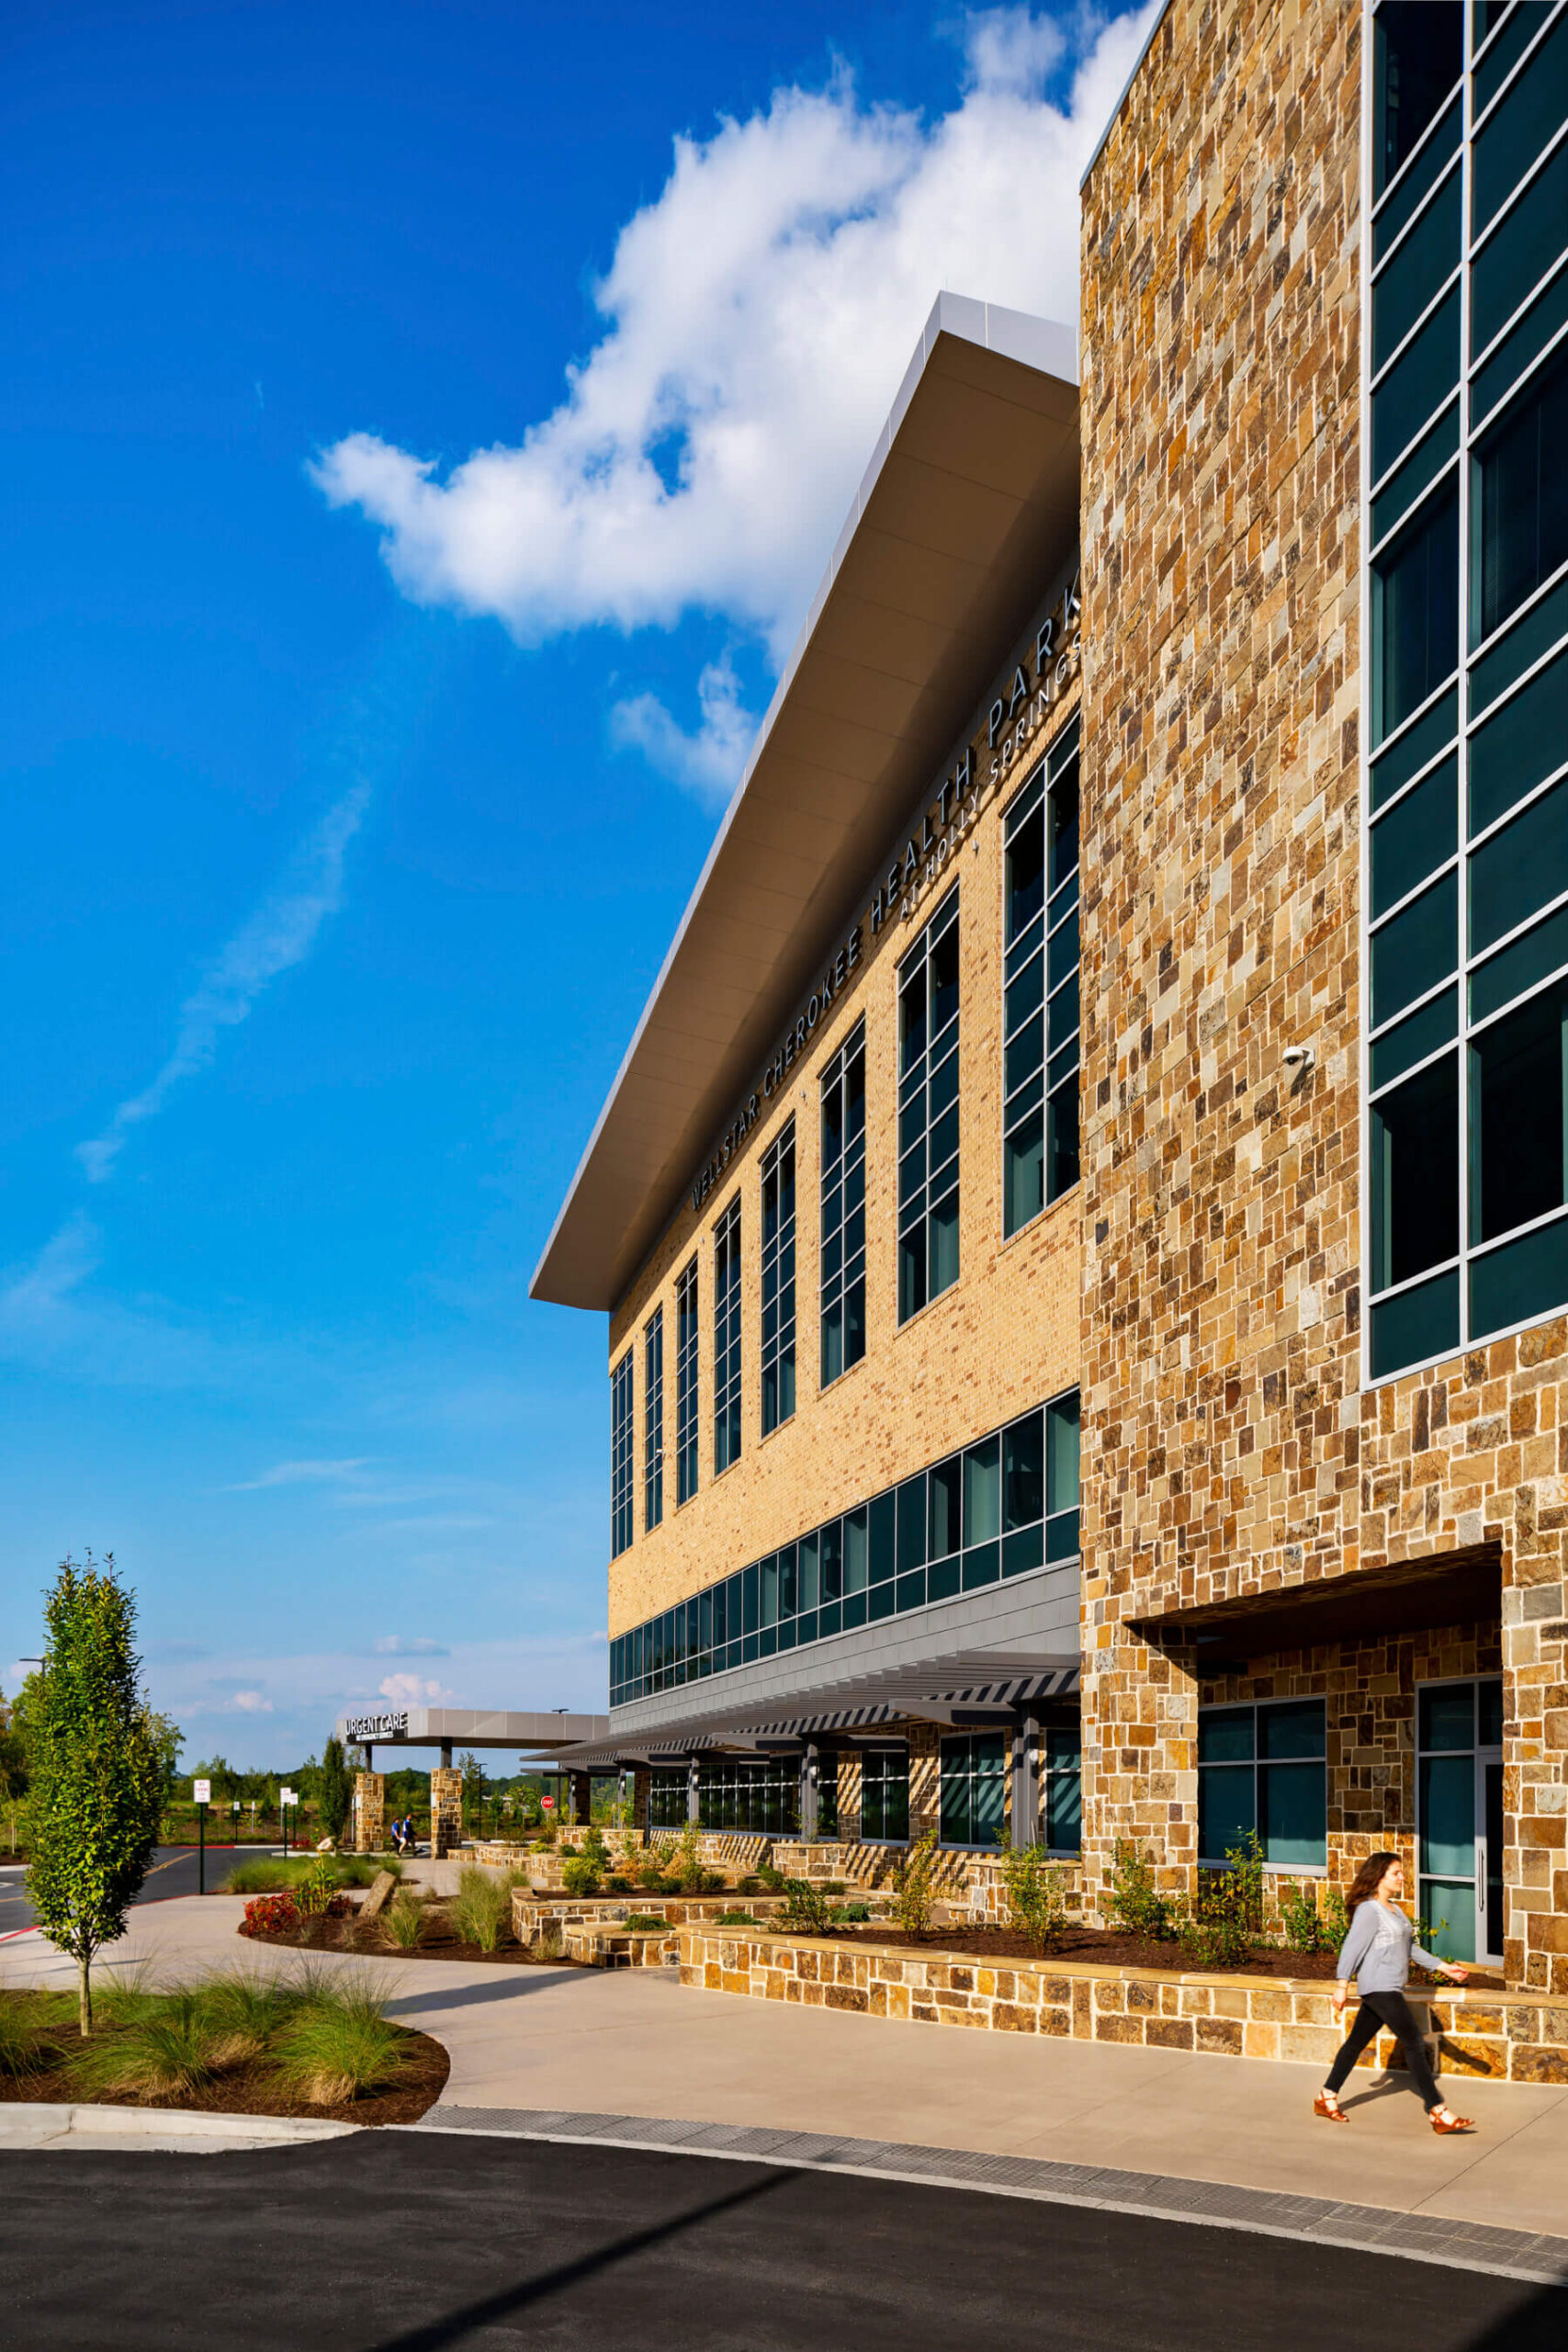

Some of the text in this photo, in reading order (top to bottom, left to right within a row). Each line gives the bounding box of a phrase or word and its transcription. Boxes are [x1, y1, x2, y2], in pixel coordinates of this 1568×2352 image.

[692, 567, 1081, 1210] WELLSTAR CHEROKEE HEALTH PARK
[899, 630, 1081, 922] AT HOLLY SPRINGS
[344, 1712, 405, 1736] URGENT CARE
